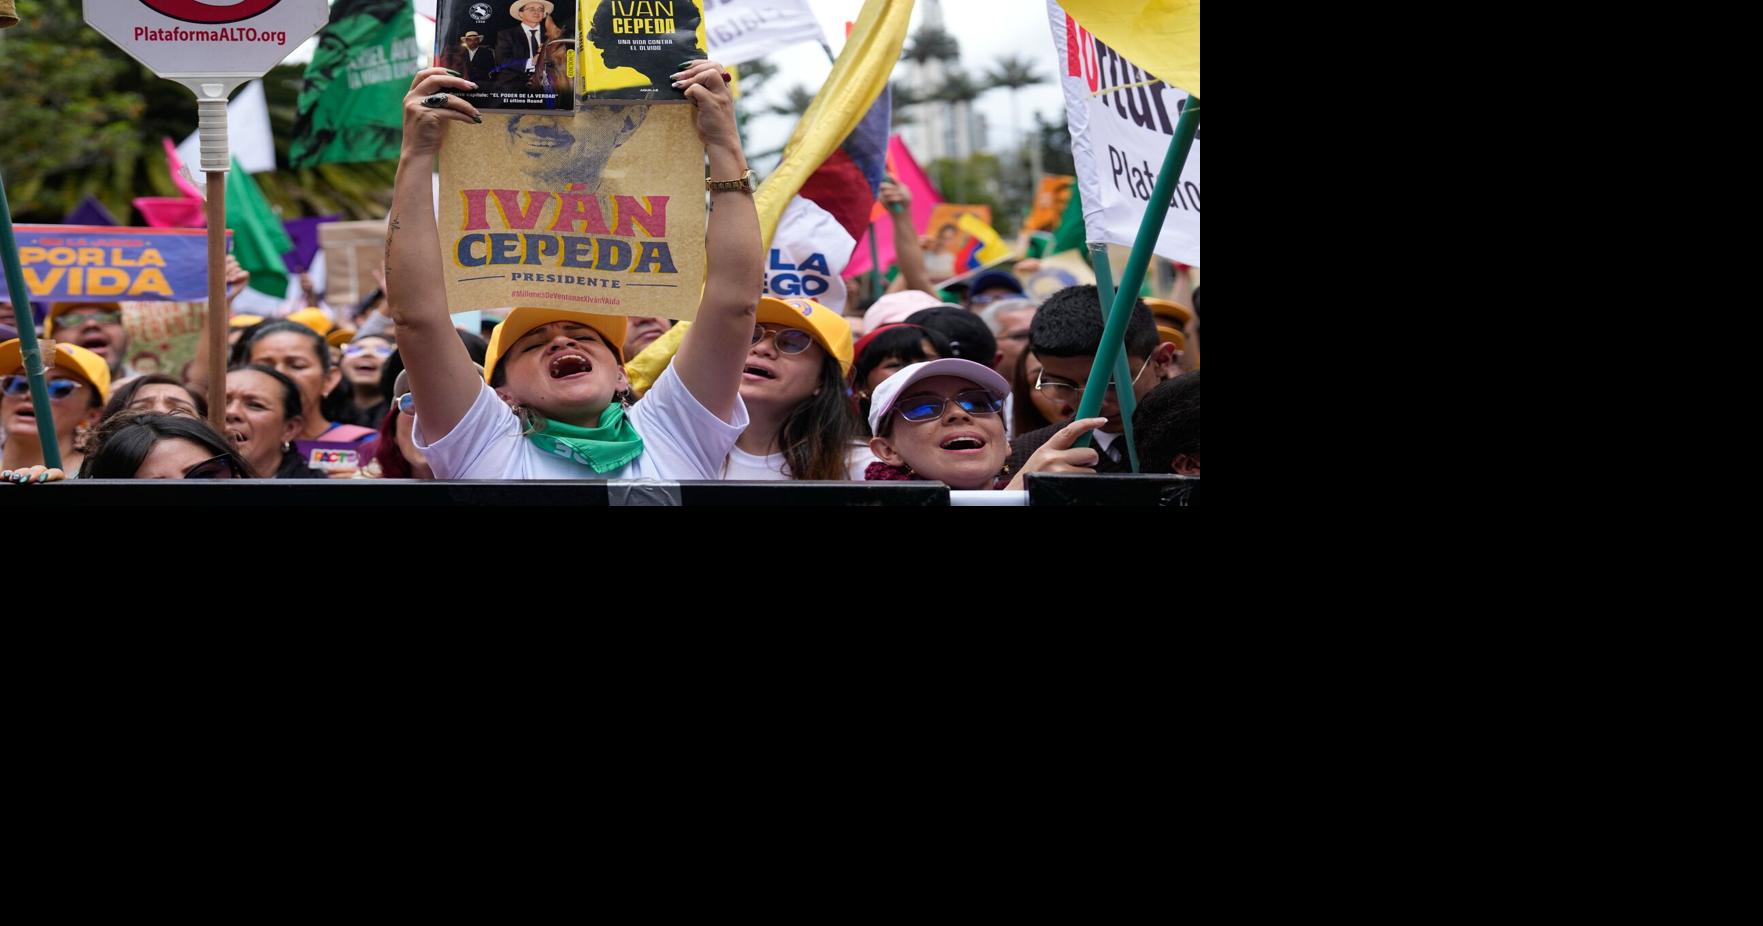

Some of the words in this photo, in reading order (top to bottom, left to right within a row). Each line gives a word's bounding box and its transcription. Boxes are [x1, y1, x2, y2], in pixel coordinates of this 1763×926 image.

[134, 26, 286, 46] PlataformaALTO.org
[613, 18, 676, 34] CEPEDA
[459, 183, 670, 238] IVÁN
[18, 246, 105, 267] POR
[111, 248, 167, 267] LA
[453, 233, 679, 274] CEPEDA
[21, 267, 175, 296] VIDA
[511, 272, 621, 289] PRESIDENTE
